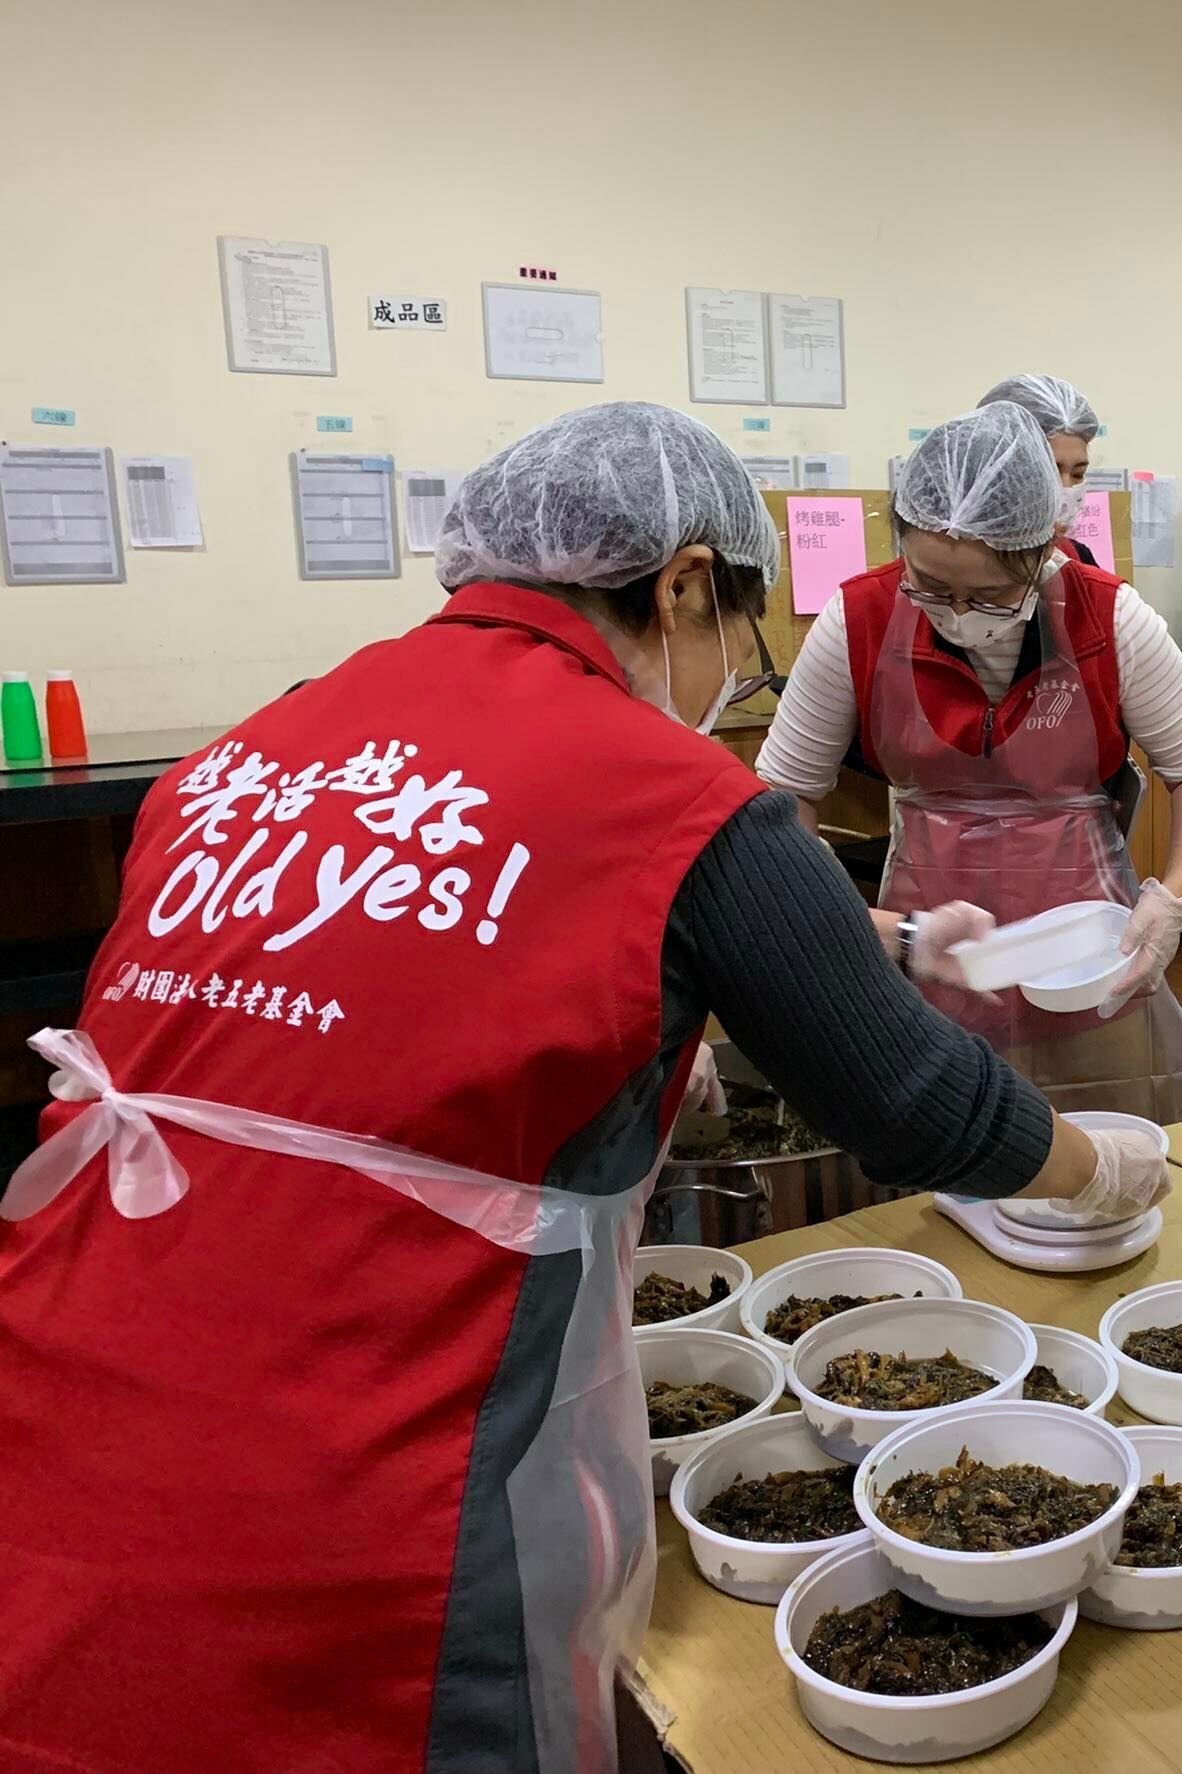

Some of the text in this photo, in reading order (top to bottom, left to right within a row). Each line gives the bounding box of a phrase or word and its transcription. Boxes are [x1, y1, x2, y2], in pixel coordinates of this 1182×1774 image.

[373, 299, 444, 324] 成品區
[796, 533, 828, 549] 粉紅
[165, 739, 489, 855] 越老活越好
[147, 827, 308, 938] Old
